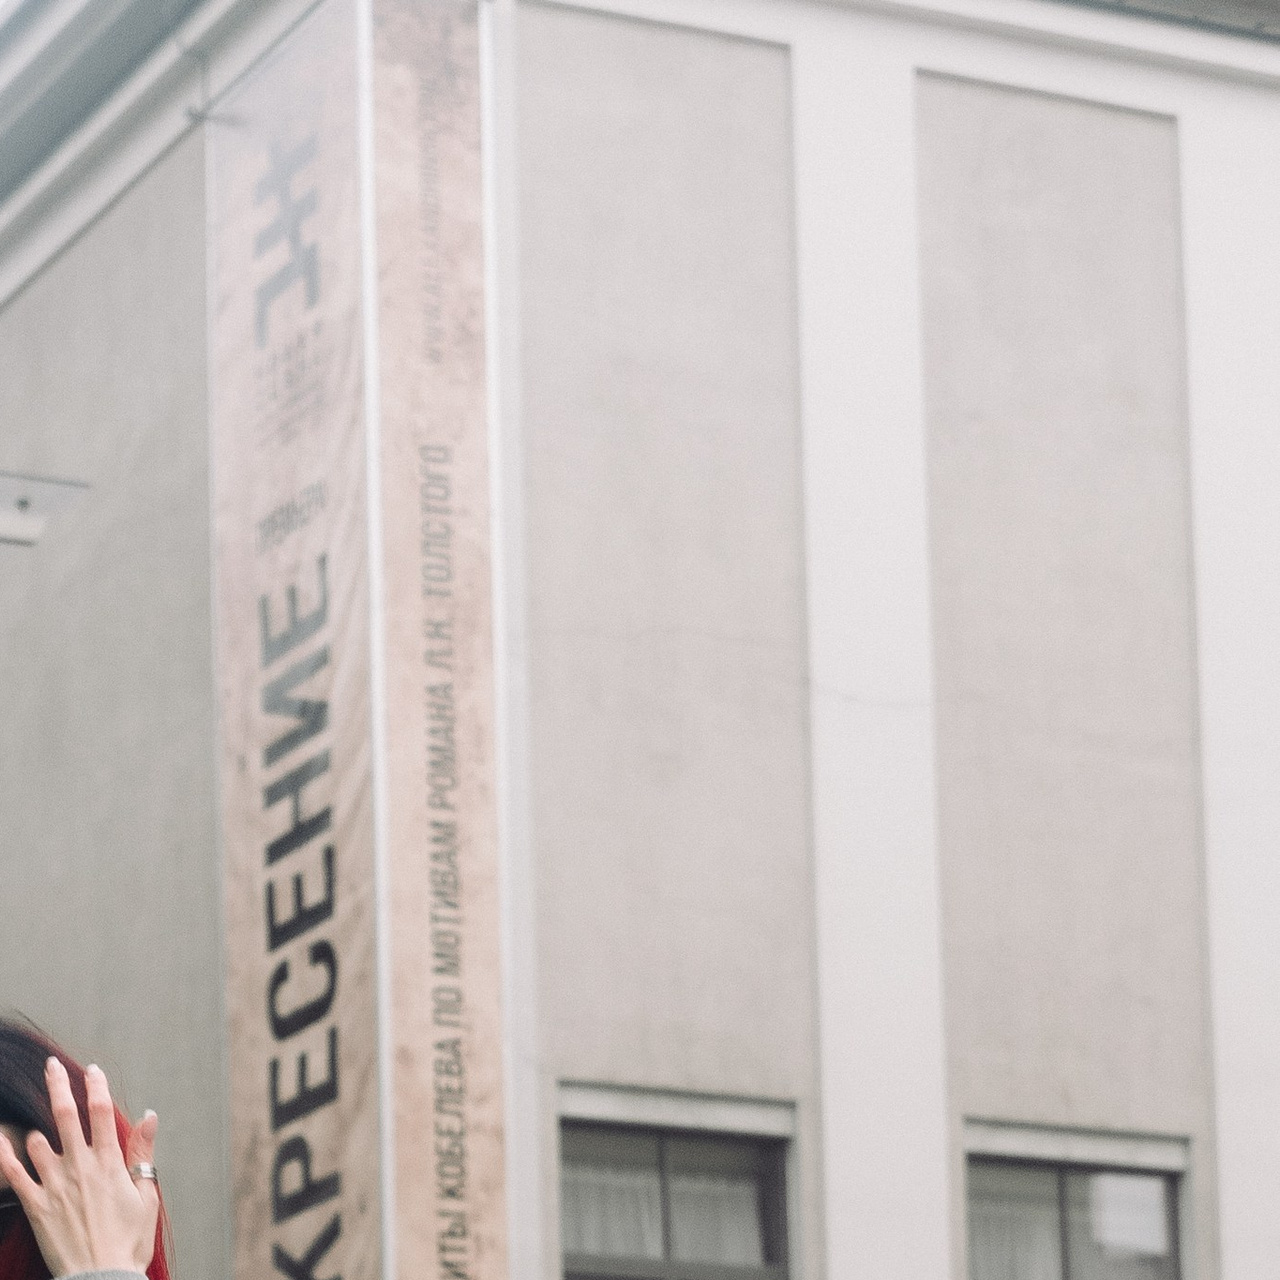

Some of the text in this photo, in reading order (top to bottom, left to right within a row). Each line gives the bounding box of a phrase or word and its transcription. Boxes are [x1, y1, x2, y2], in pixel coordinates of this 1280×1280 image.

[421, 445, 454, 600] ТОЛСТОГО
[426, 680, 458, 811] РОМАНА
[430, 820, 462, 979] МОТИВАМ
[432, 985, 464, 1028] ПО
[434, 1036, 467, 1202] КОБЕЛЕВА
